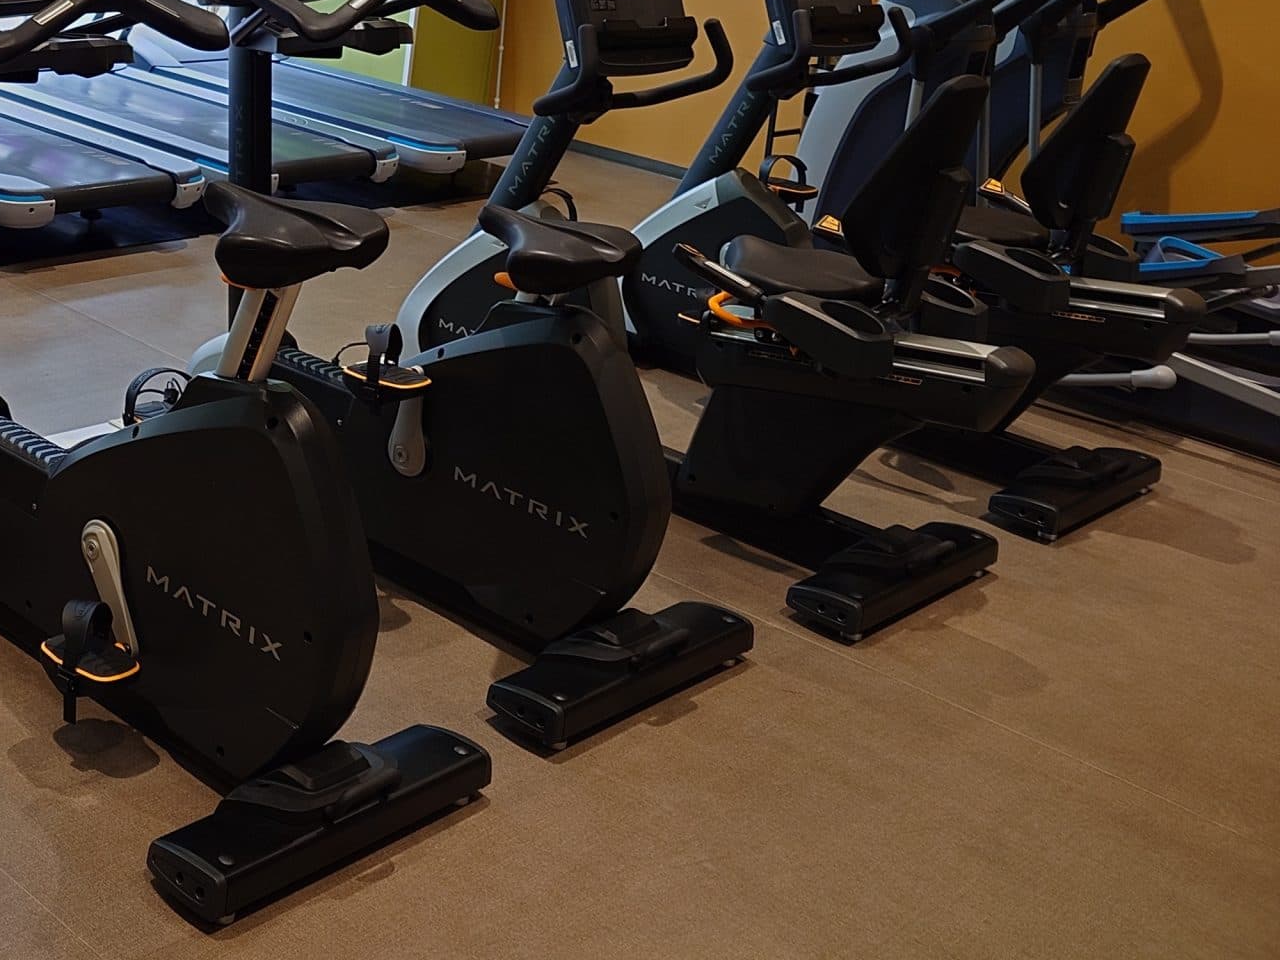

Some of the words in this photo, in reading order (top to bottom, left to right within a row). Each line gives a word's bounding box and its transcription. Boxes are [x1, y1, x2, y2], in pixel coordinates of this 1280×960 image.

[508, 115, 556, 195] MATRI
[709, 87, 754, 164] MATRI
[641, 272, 698, 299] MATR
[454, 466, 589, 539] MATRIX
[147, 566, 283, 661] MATRIX
